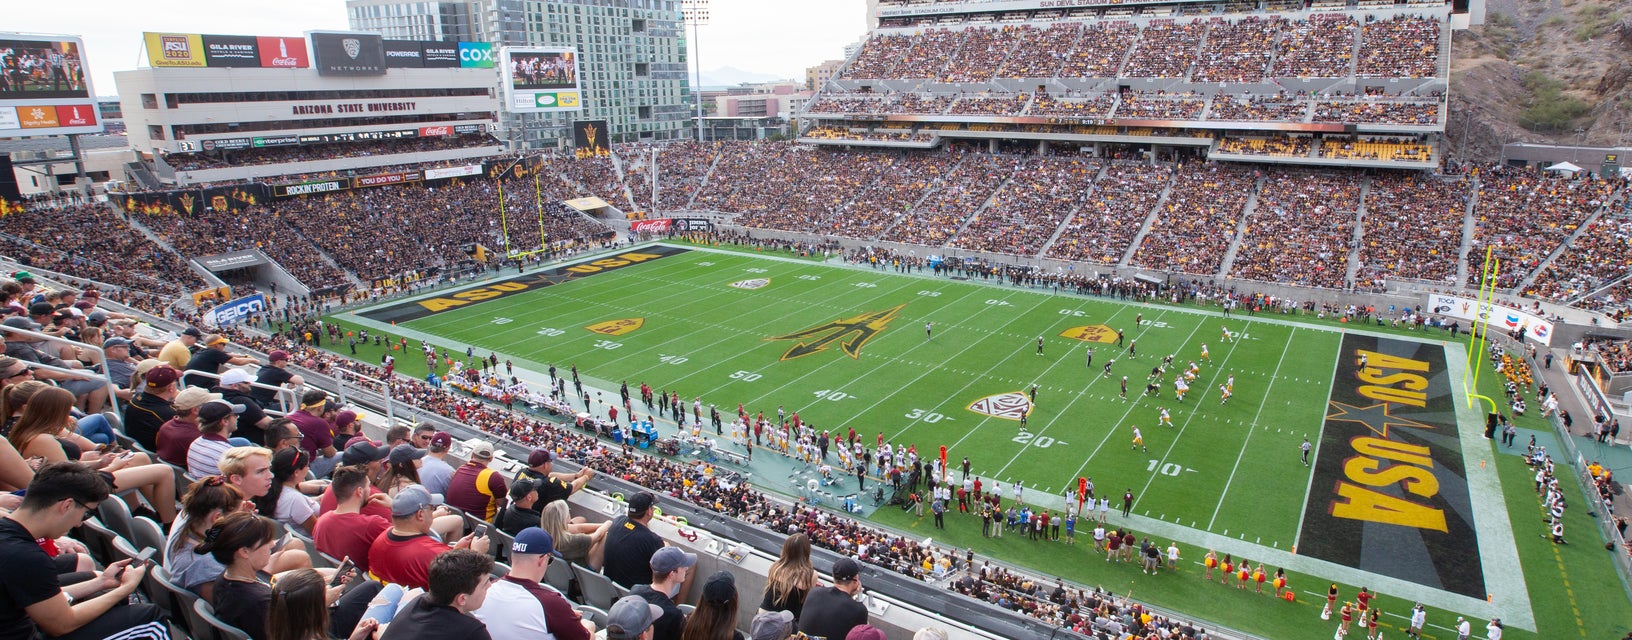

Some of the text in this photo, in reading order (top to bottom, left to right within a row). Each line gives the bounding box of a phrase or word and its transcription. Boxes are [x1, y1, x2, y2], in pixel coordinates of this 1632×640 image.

[165, 41, 187, 51] ASU
[460, 49, 492, 61] COX
[293, 102, 416, 115] ARIZONA STATE UNIVERSITY
[254, 137, 297, 146] enterprise
[361, 177, 376, 185] YOU
[377, 176, 386, 184] DO
[386, 174, 400, 183] YOU
[312, 181, 339, 192] PROTEIN
[567, 252, 663, 274] USA
[417, 282, 529, 312] ASU
[1438, 297, 1455, 305] TOCA
[216, 300, 262, 323] GEICO
[1058, 308, 1086, 317] 30
[1140, 319, 1168, 328] 20
[536, 328, 565, 337] 20
[593, 340, 623, 350] 30
[660, 355, 688, 365] 40
[729, 370, 763, 382] 50
[1354, 349, 1430, 408] ASU
[813, 389, 847, 401] 40
[904, 408, 944, 424] 30
[1012, 432, 1054, 448] 20
[1148, 460, 1182, 477] 10
[1327, 435, 1449, 534] USA
[512, 542, 528, 552] SMU
